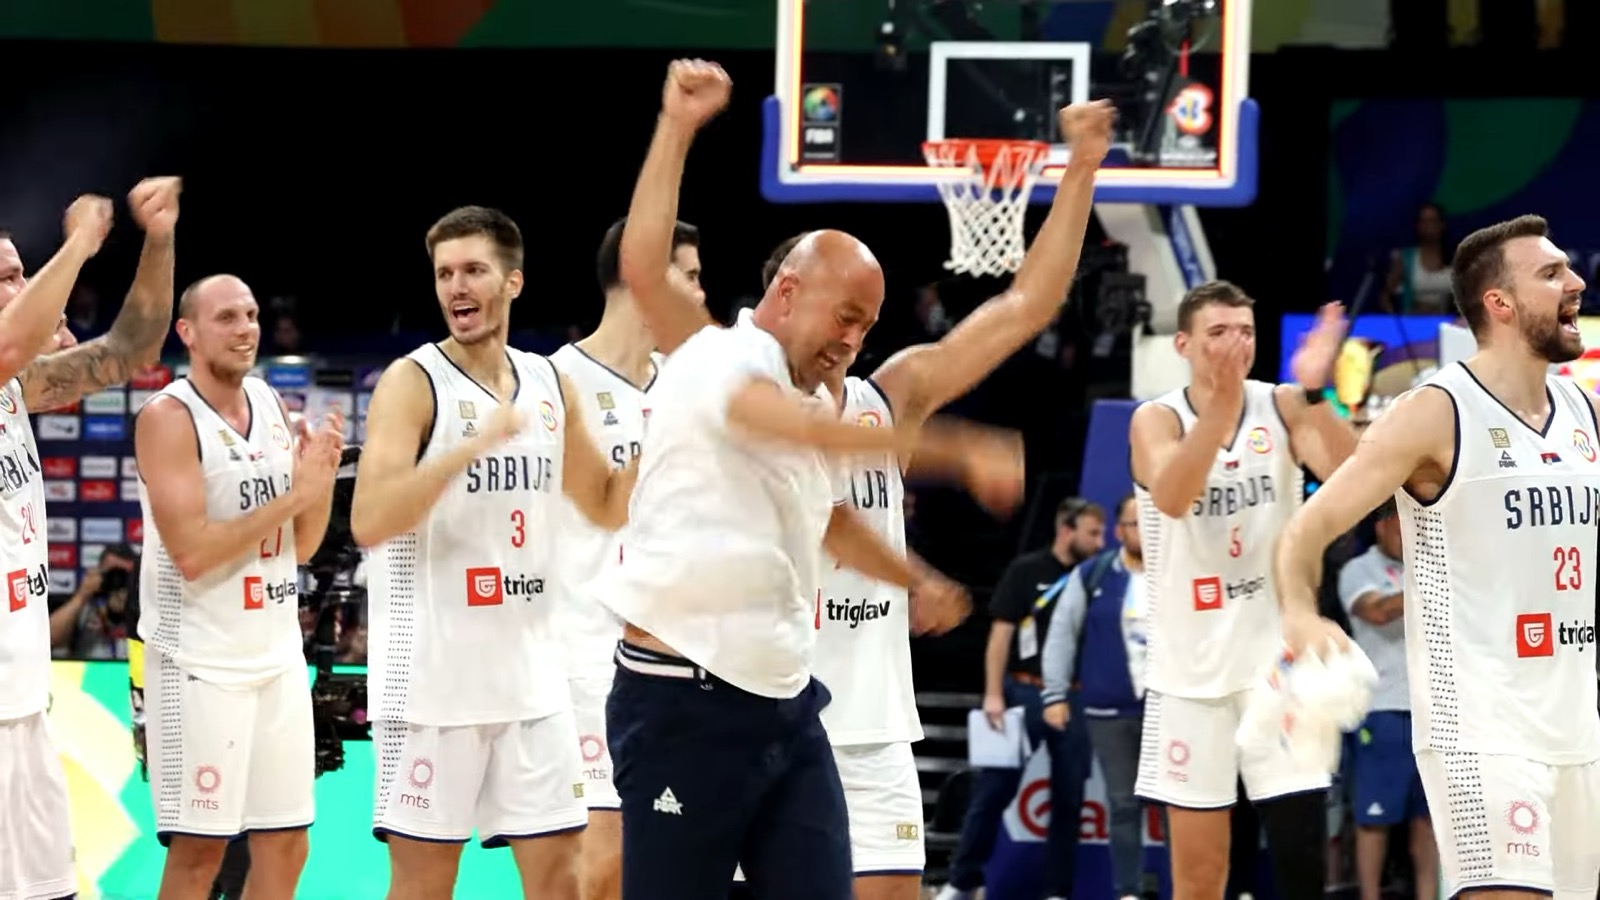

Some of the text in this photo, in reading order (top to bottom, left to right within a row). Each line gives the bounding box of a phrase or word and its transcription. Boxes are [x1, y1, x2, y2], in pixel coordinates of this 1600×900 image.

[510, 509, 526, 549] 3
[1229, 525, 1242, 558] 5
[1553, 547, 1582, 591] 23
[826, 597, 891, 629] triglav
[1558, 620, 1595, 652] trigla
[191, 798, 220, 811] mts
[400, 793, 430, 810] mts
[1506, 842, 1541, 858] mts
